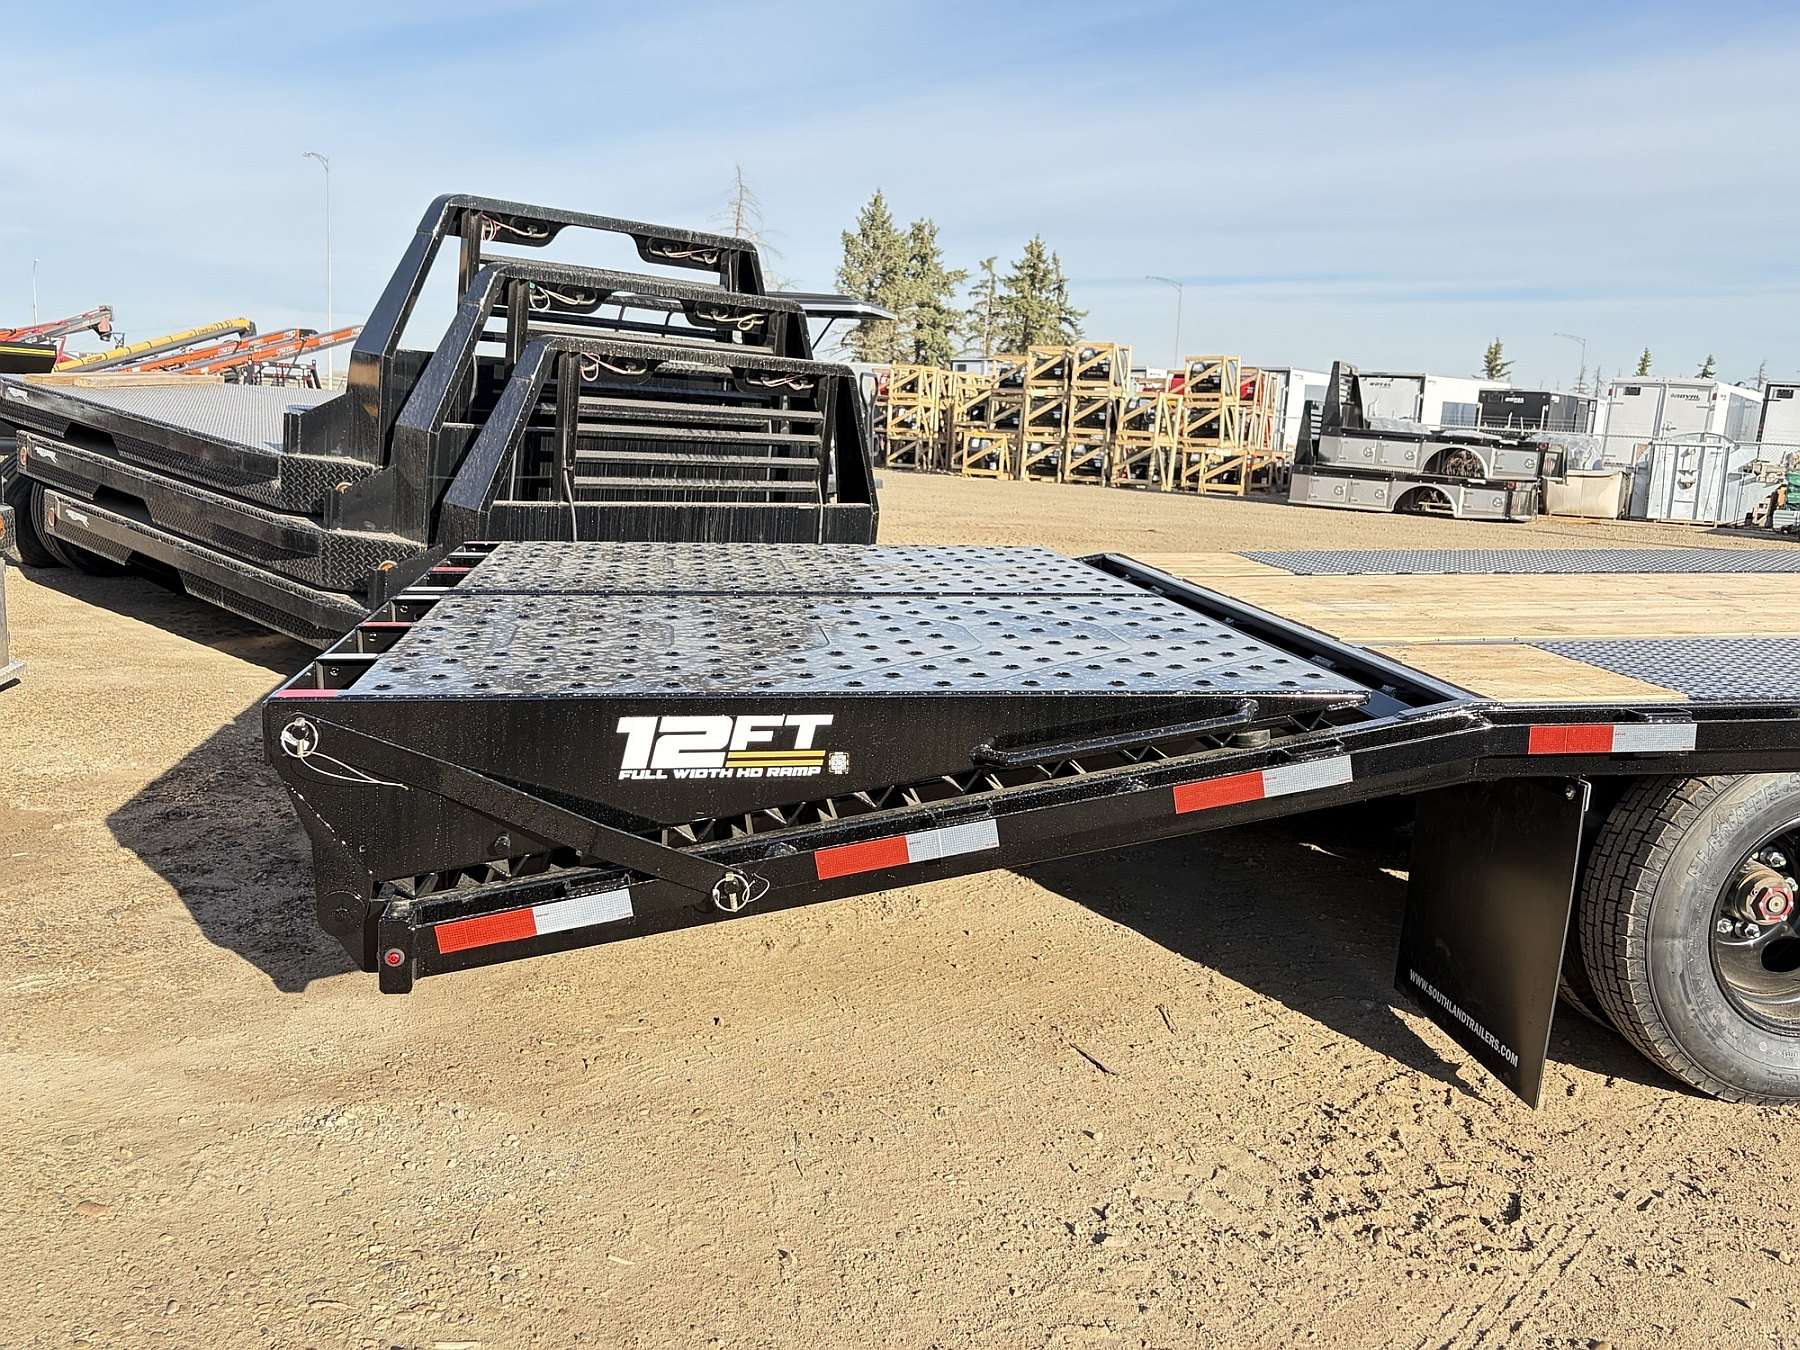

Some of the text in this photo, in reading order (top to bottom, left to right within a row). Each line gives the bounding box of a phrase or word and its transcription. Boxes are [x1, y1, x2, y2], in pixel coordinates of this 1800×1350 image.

[616, 714, 834, 769] 12FT
[618, 766, 822, 780] FULL WIDTH HD RAMP
[1410, 969, 1519, 1067] WWW.SOUTHLANDTRAILERS.COM
